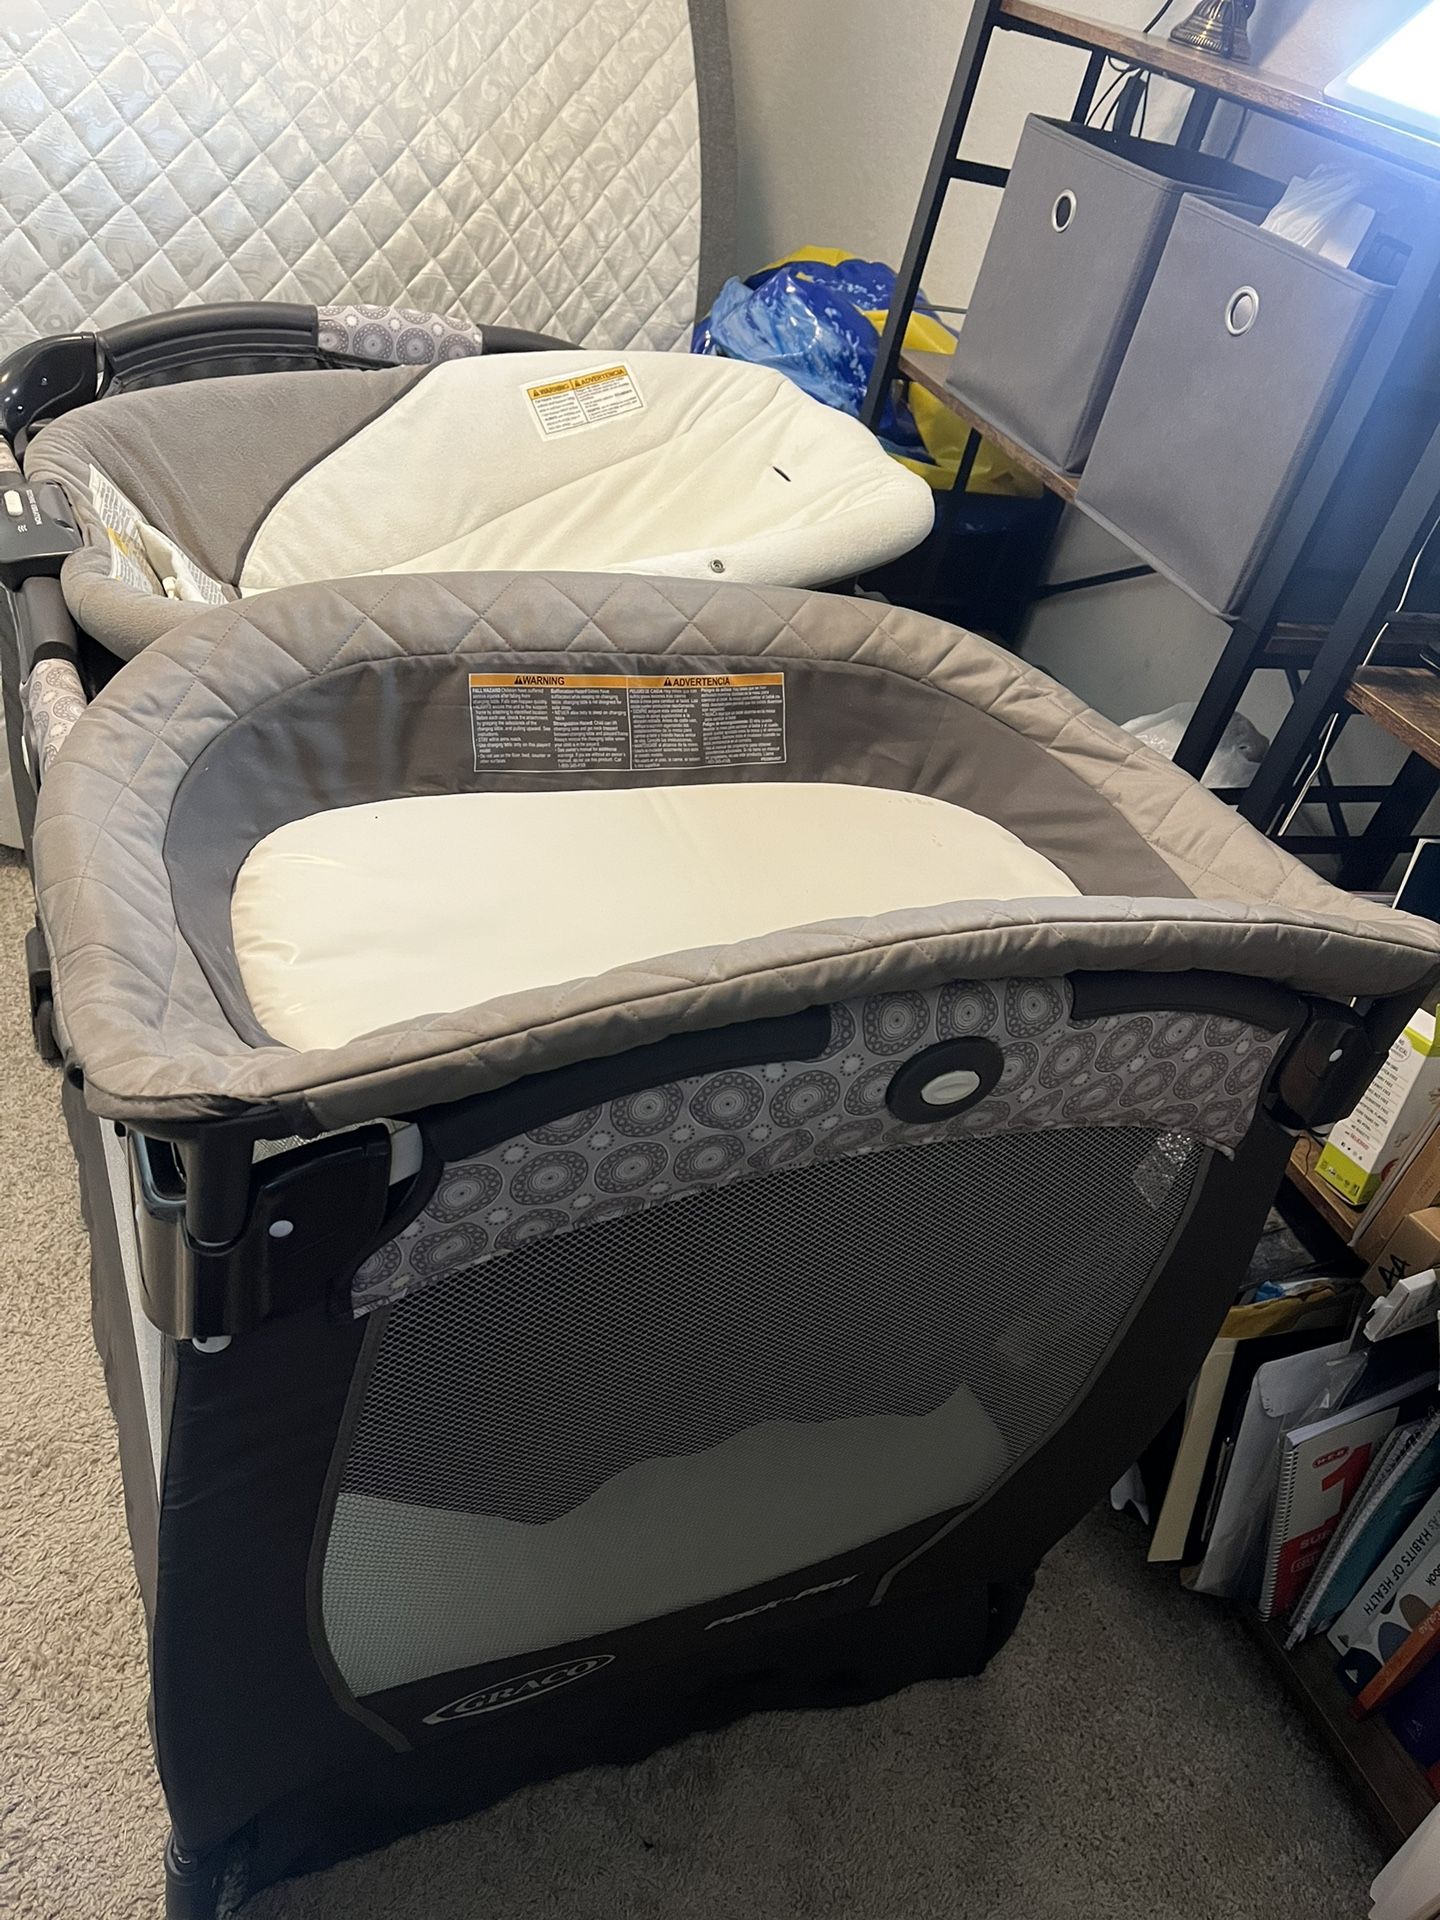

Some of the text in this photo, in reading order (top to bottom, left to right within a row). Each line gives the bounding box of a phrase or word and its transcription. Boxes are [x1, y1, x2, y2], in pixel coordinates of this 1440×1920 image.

[522, 676, 565, 685] WARNING
[673, 677, 731, 687] ADVERTENCIA
[1401, 1528, 1433, 1567] HABITS
[1391, 1564, 1404, 1580] OF
[1363, 1576, 1394, 1616] HEALTH
[455, 1660, 598, 1712] GRACO
